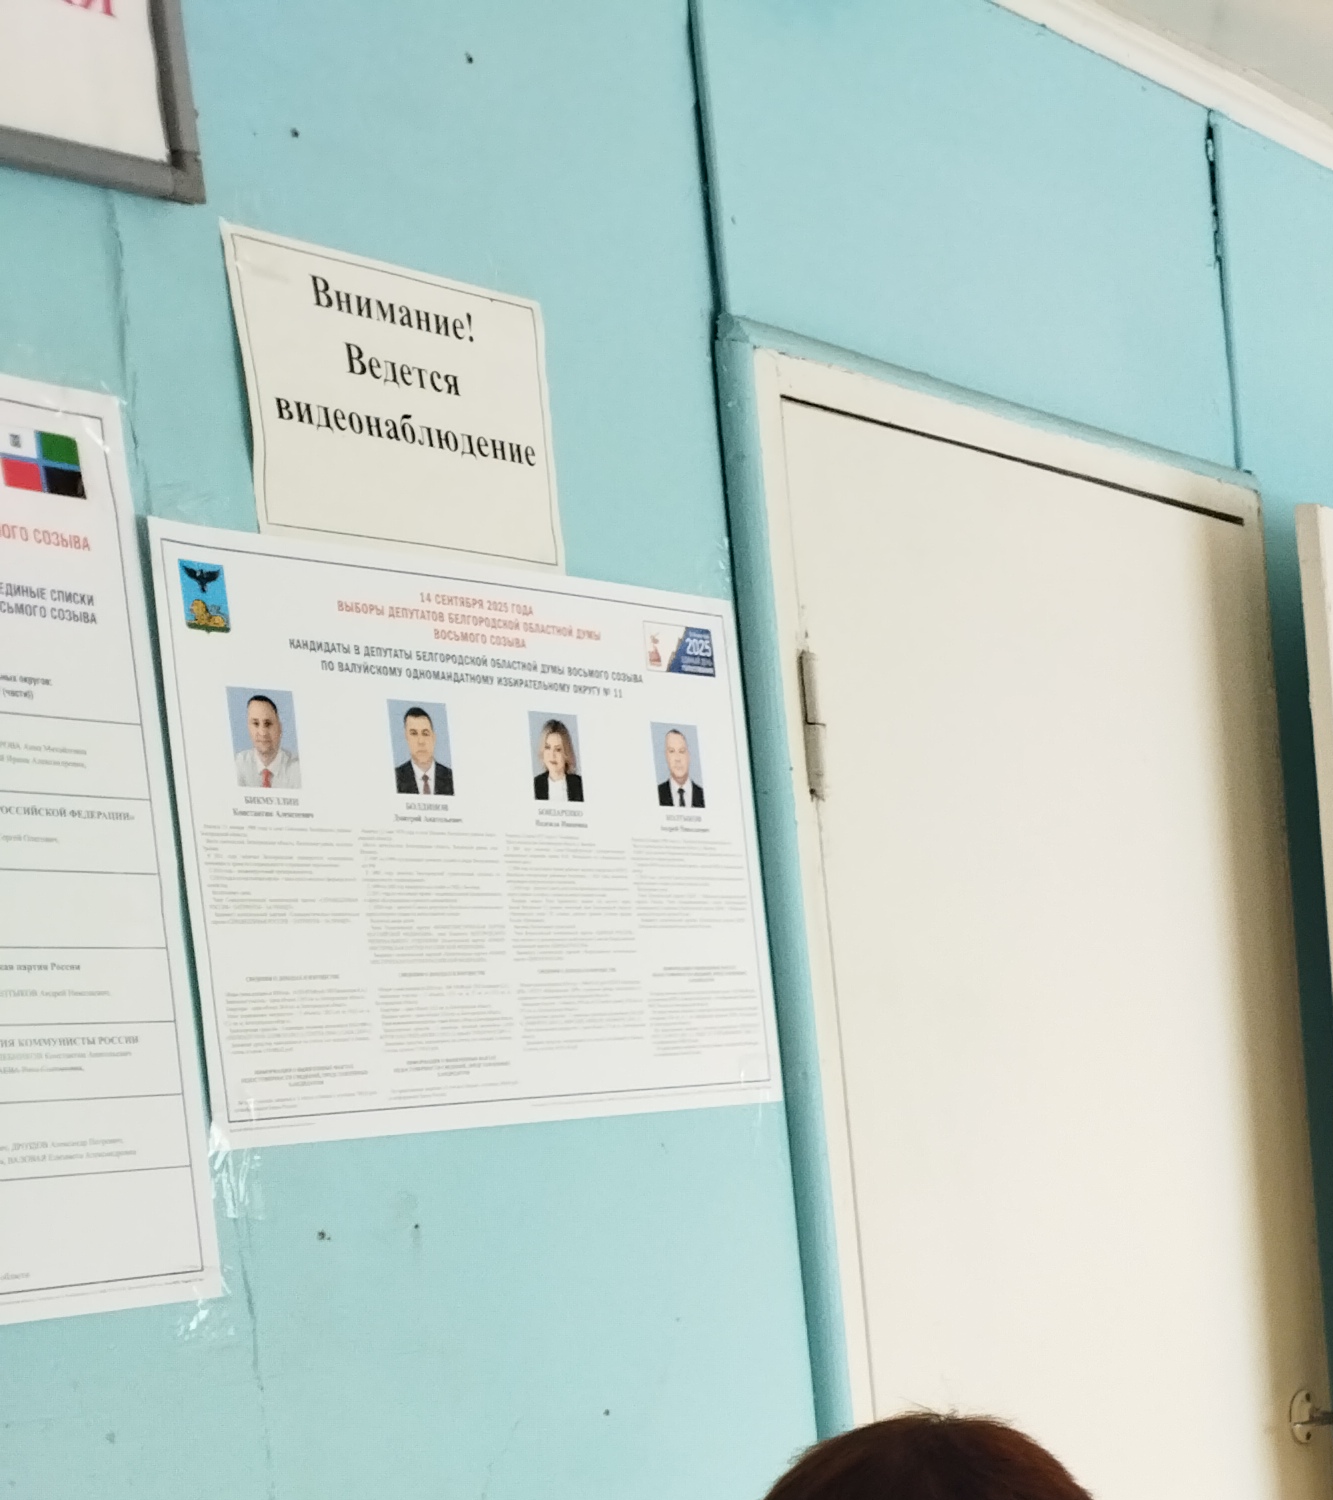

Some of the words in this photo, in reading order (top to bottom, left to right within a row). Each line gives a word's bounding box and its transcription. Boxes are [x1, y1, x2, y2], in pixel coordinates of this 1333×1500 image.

[311, 274, 473, 342] Внимание!
[344, 342, 460, 396] Ведется
[275, 397, 535, 467] видеонаблюдение
[32, 529, 90, 551] СОЗЫВА
[50, 589, 94, 606] СПИСКИ
[419, 592, 432, 603] 14
[434, 593, 484, 609] СЕНТЯБРЯ
[486, 599, 508, 613] 2025
[510, 603, 533, 616] ГОДА
[50, 607, 96, 624] СОЗЫВА
[336, 600, 384, 616] ВЫБОРЫ
[388, 605, 444, 623] ДЕПУТАТОВ
[447, 612, 520, 630] БЕЛГОРОДСКОЙ
[522, 621, 573, 637] ОБЛАСТНОЙ
[576, 628, 600, 641] ДУМЫ
[433, 628, 487, 644] ВОСЬМОГО
[489, 634, 526, 648] СОЗЫВА
[685, 637, 712, 657] 2025
[288, 638, 350, 654] КАНДИДАТЫ
[353, 644, 360, 655] В
[363, 645, 412, 660] ДЕПУТАТЫ
[415, 650, 488, 667] БЕЛГОРОДСКОЙ
[490, 657, 538, 672] ОБЛАСТНОЙ
[540, 663, 564, 675] ДУМЫ
[567, 666, 608, 680] ВОСЬМОГО
[611, 671, 642, 683] СОЗЫВА
[320, 659, 334, 672] ПО
[337, 661, 402, 677] ВАЛУЙСКОМУ
[405, 667, 494, 685] ОДНОМАНДАТНОМУ
[496, 676, 570, 693] ИЗБИРАТЕЛЬНОМУ
[572, 684, 600, 695] ОКРУГУ
[602, 687, 610, 696] №
[614, 688, 622, 698] 11
[98, 1035, 139, 1045] РОССИИ
